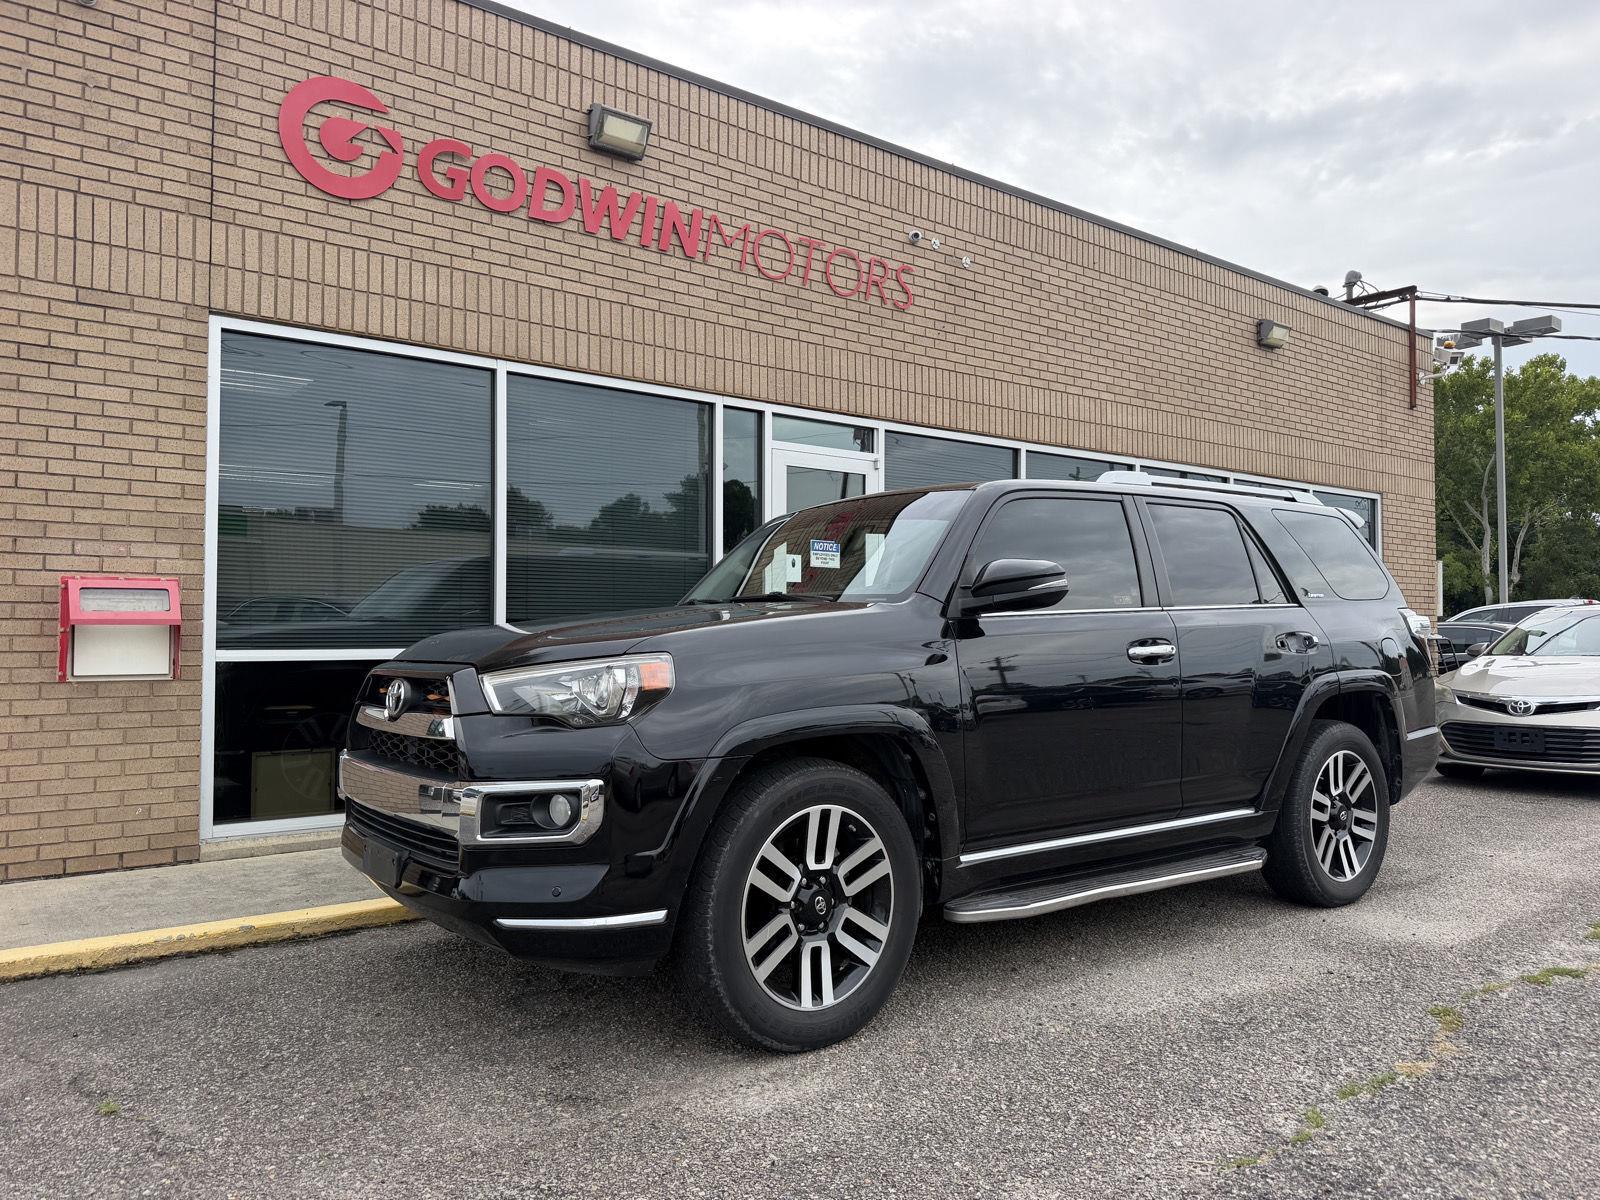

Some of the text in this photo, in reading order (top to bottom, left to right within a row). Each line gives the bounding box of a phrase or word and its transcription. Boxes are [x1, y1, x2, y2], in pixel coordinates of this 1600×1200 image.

[417, 138, 703, 258] GODWIN
[704, 214, 915, 310] MOTORS
[813, 542, 837, 551] NOTICE
